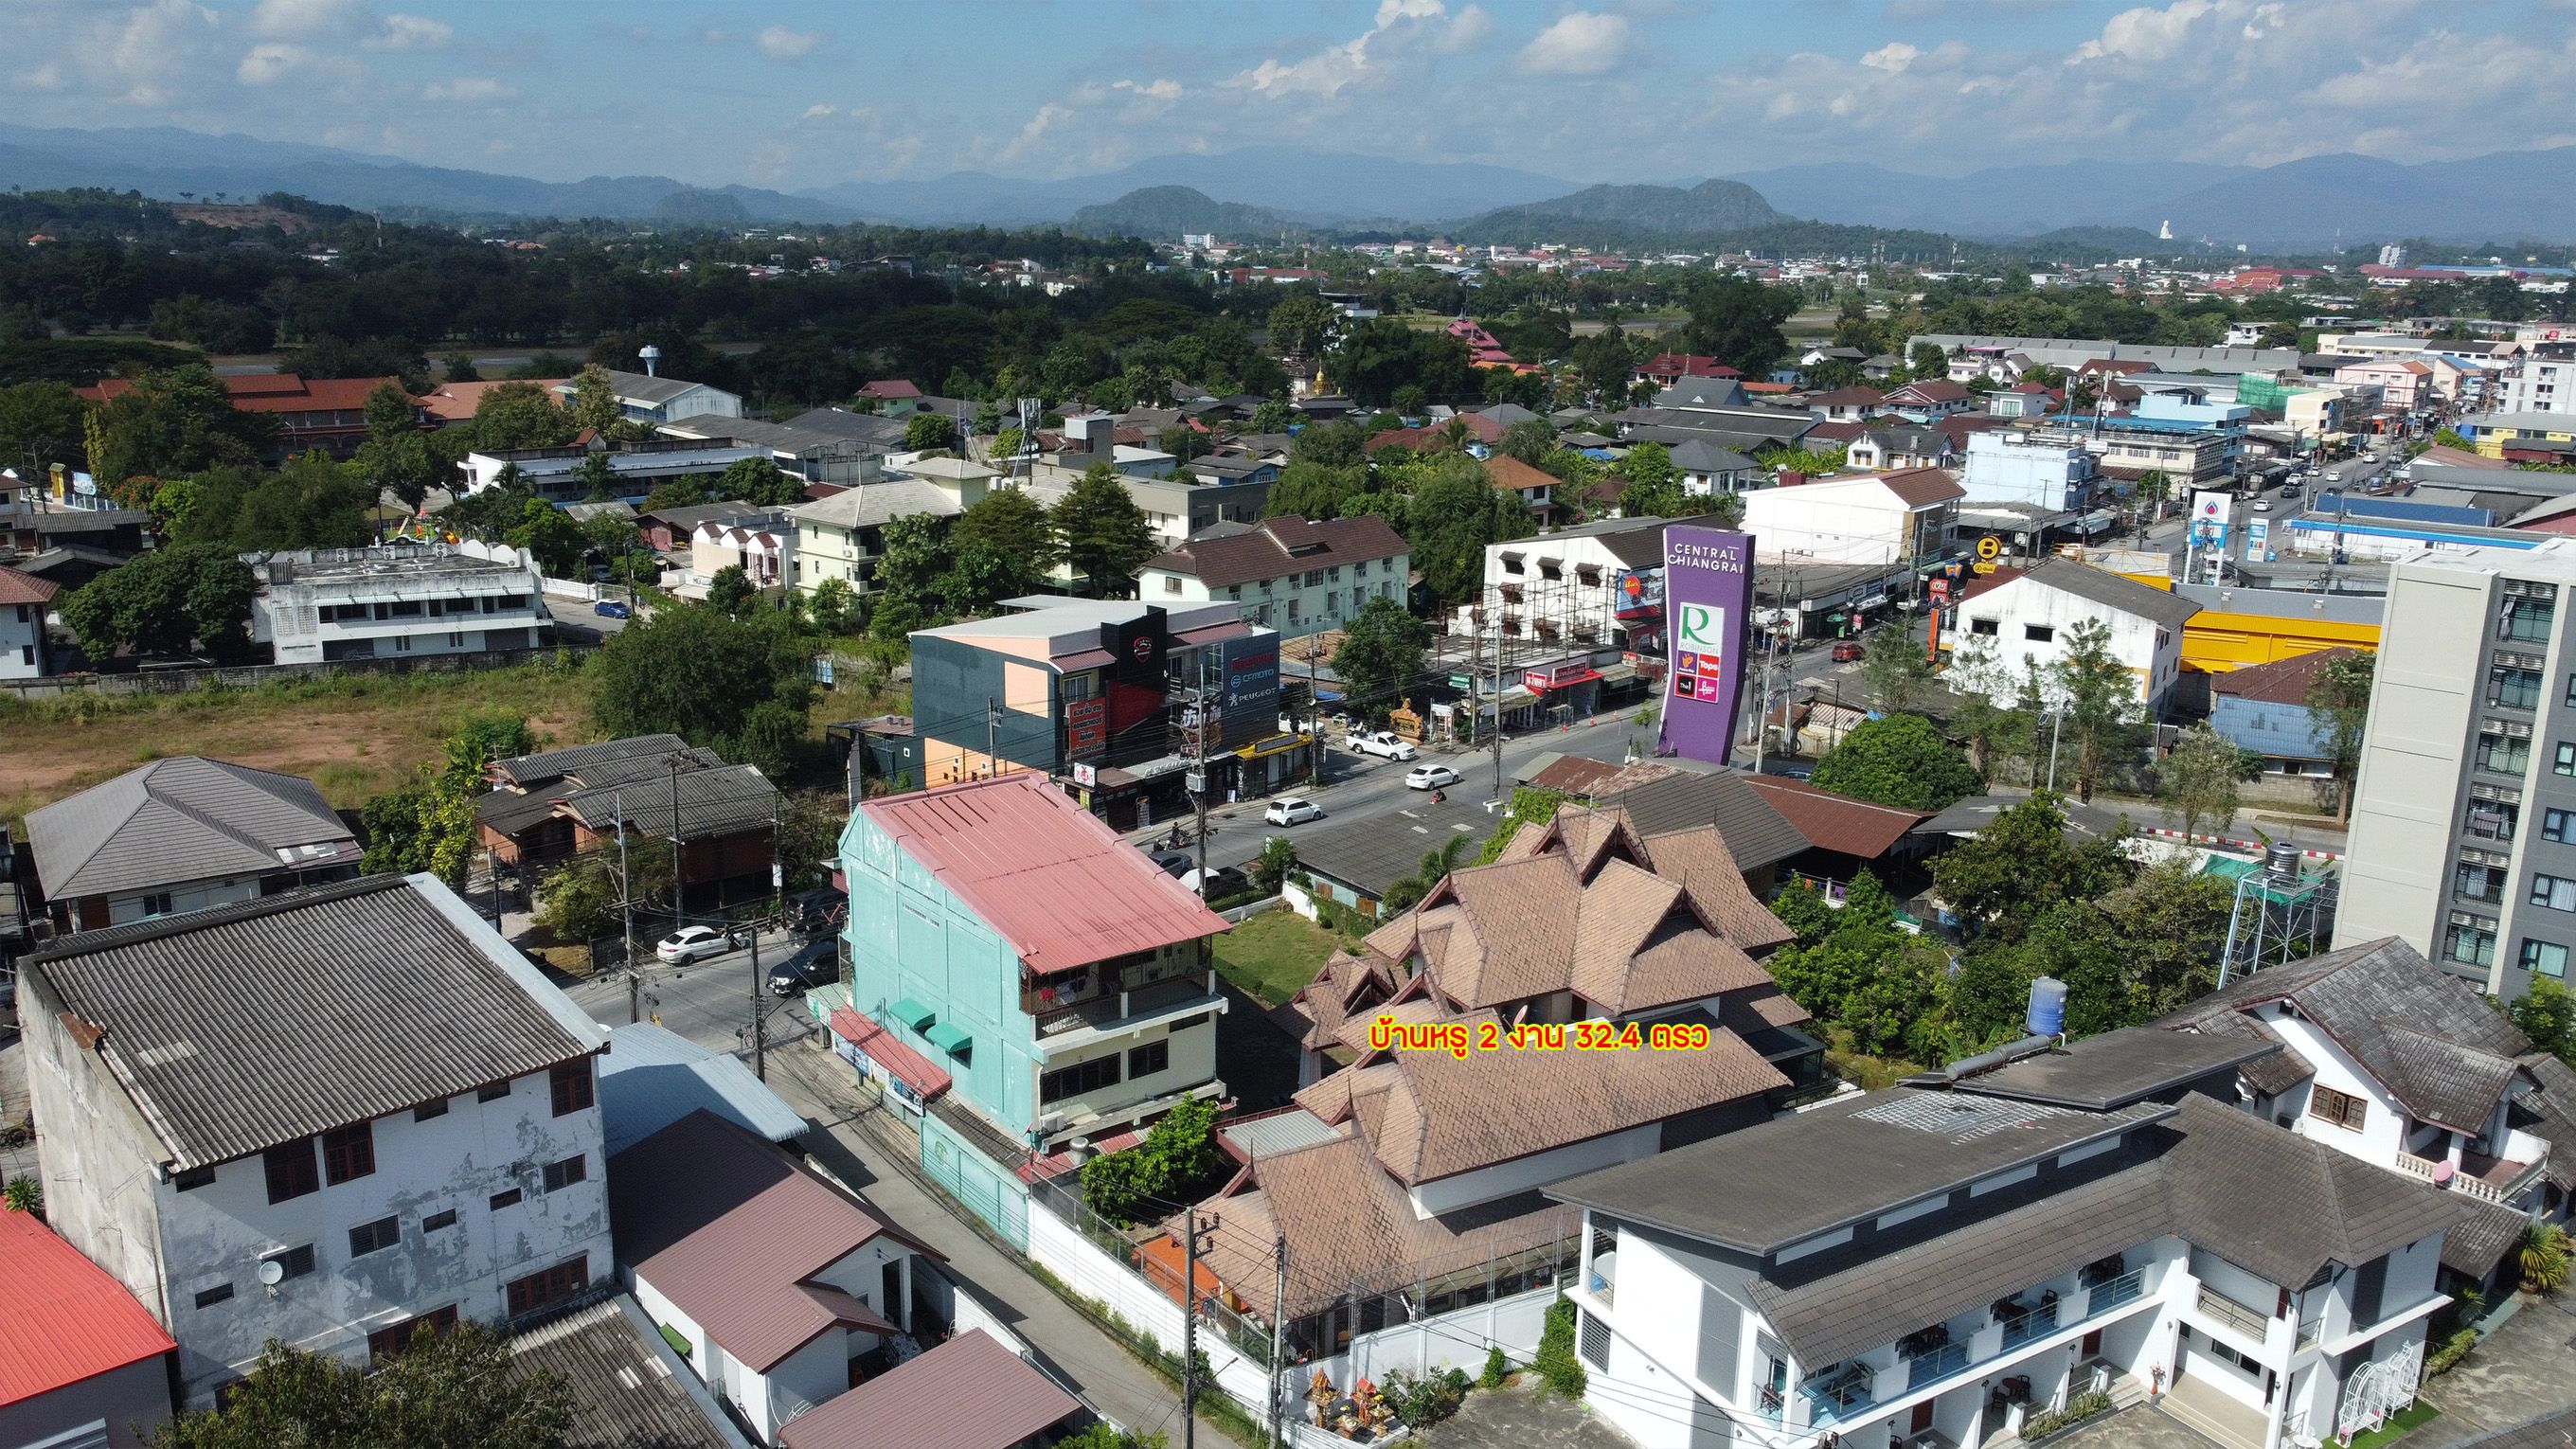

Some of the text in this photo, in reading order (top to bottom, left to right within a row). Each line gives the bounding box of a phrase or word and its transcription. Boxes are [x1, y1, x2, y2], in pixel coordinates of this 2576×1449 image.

[1674, 543, 1737, 561] CENTRAL
[1668, 554, 1744, 574] CHIANGRAI
[1680, 642, 1719, 654] ROBINSON
[1699, 660, 1719, 671] Tops
[1239, 688, 1277, 702] PEUGEOT
